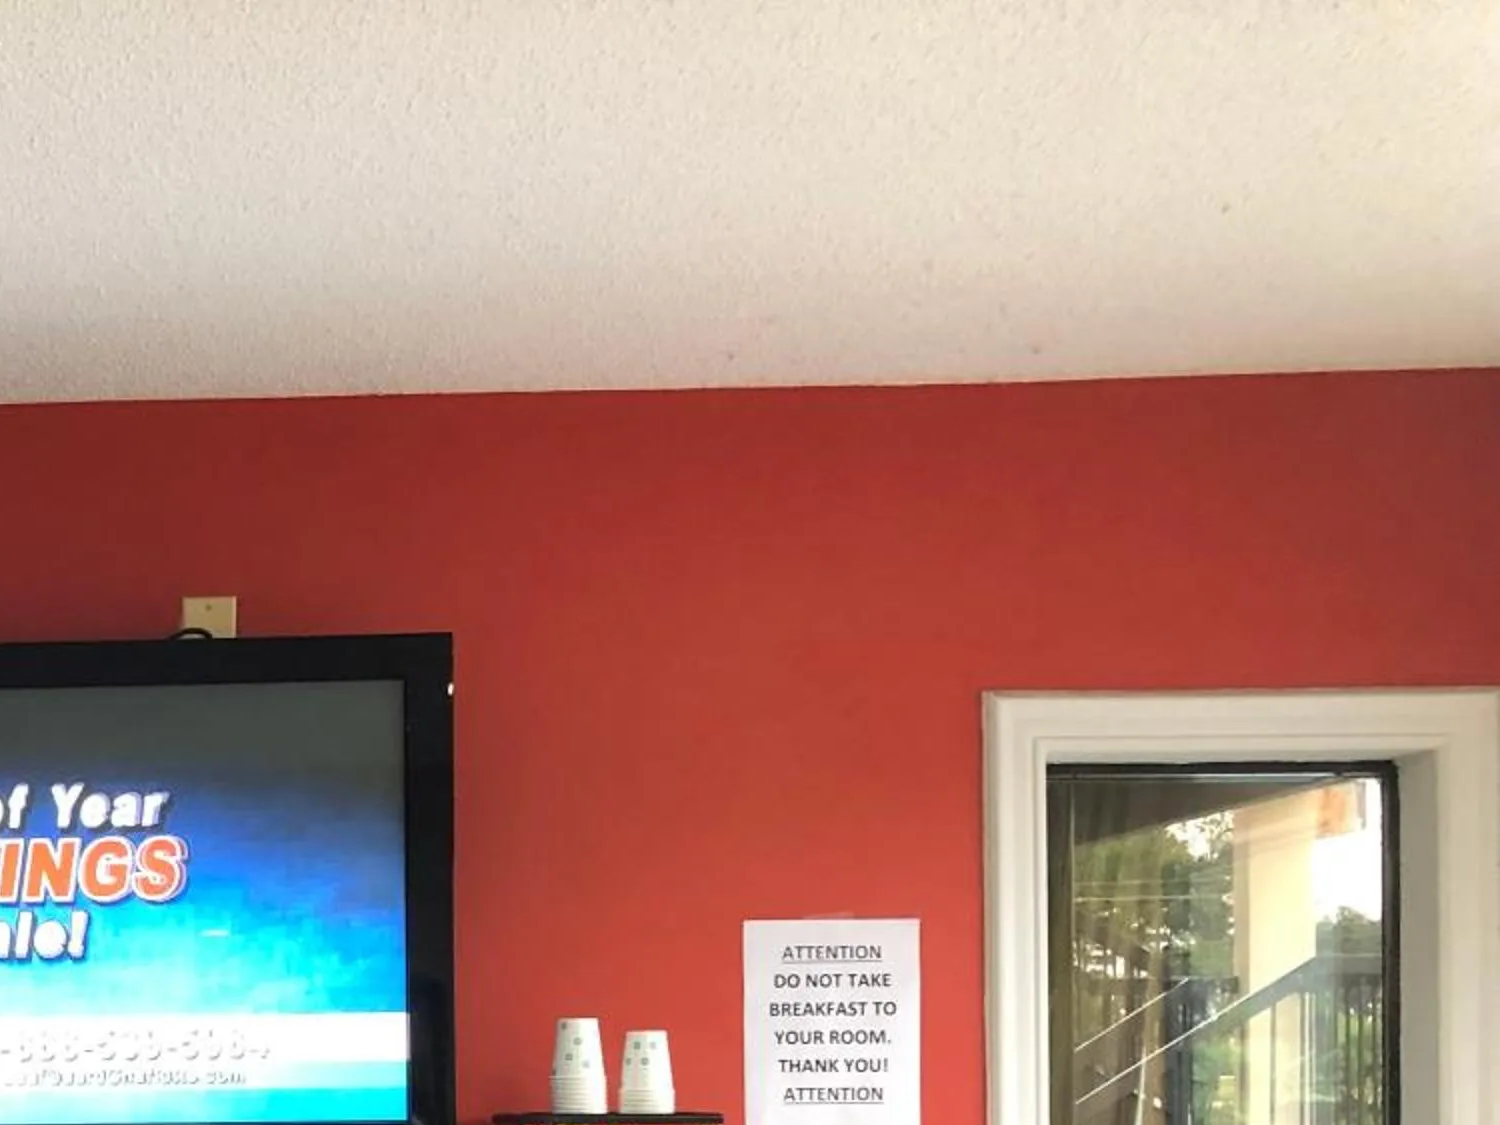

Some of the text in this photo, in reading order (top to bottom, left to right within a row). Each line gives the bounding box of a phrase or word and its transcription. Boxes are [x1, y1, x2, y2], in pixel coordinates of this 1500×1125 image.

[51, 783, 169, 830] Year
[782, 945, 882, 962] ATTENTION
[773, 973, 892, 989] DO NOT TAKE
[769, 1001, 897, 1017] BREAKFAST TO
[774, 1030, 892, 1045] YOUR ROOM.
[778, 1058, 889, 1073] THANK YOU!
[783, 1087, 884, 1103] ATTENTION
